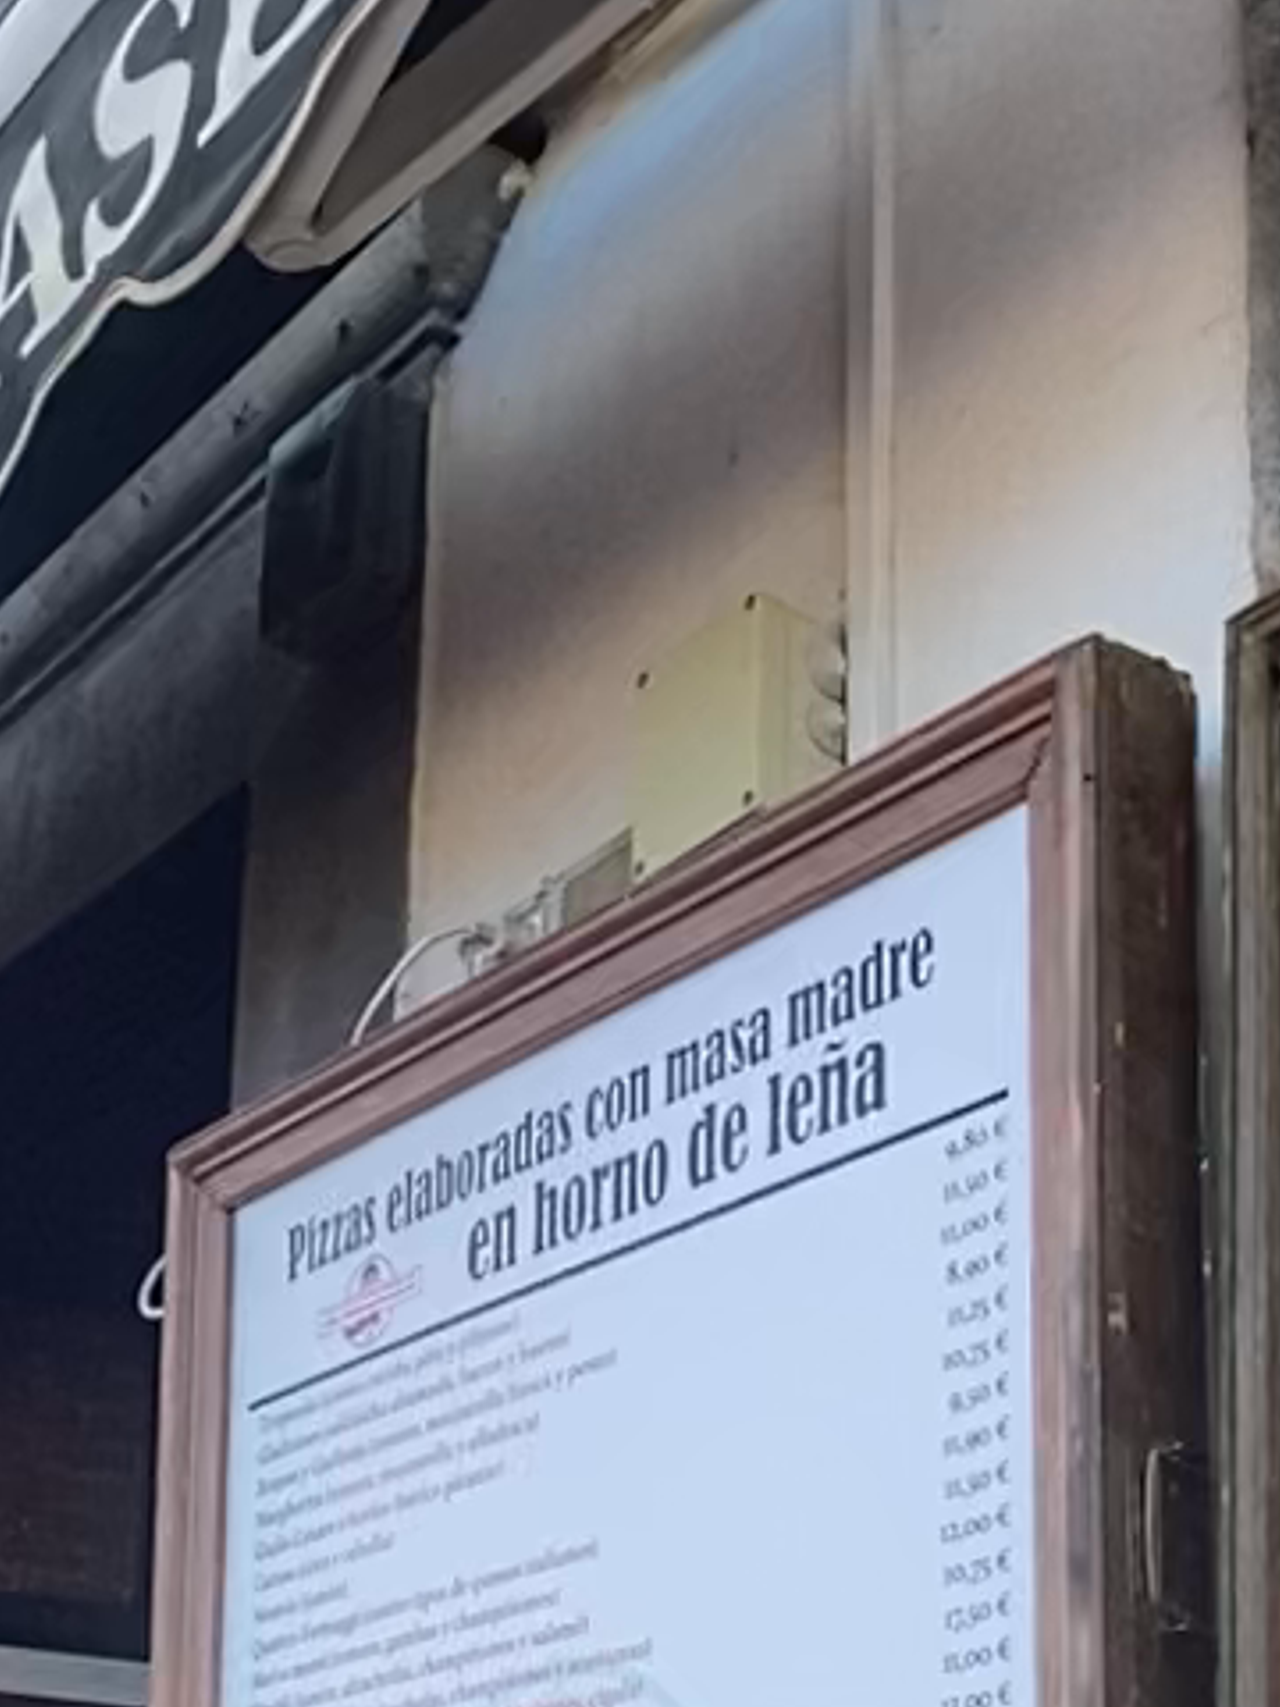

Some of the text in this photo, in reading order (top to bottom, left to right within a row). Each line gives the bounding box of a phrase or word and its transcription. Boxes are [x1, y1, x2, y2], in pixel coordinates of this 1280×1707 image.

[286, 924, 936, 1283] Pizzas elaboradas con masa madre
[993, 1115, 1007, 1138] €
[466, 1036, 888, 1281] en horno de leña
[991, 1199, 1007, 1226] €
[995, 1328, 1009, 1354] €
[993, 1502, 1011, 1528] €
[996, 1547, 1011, 1573] €
[996, 1591, 1010, 1617] €
[994, 1636, 1010, 1662] €
[994, 1680, 1011, 1706] €
